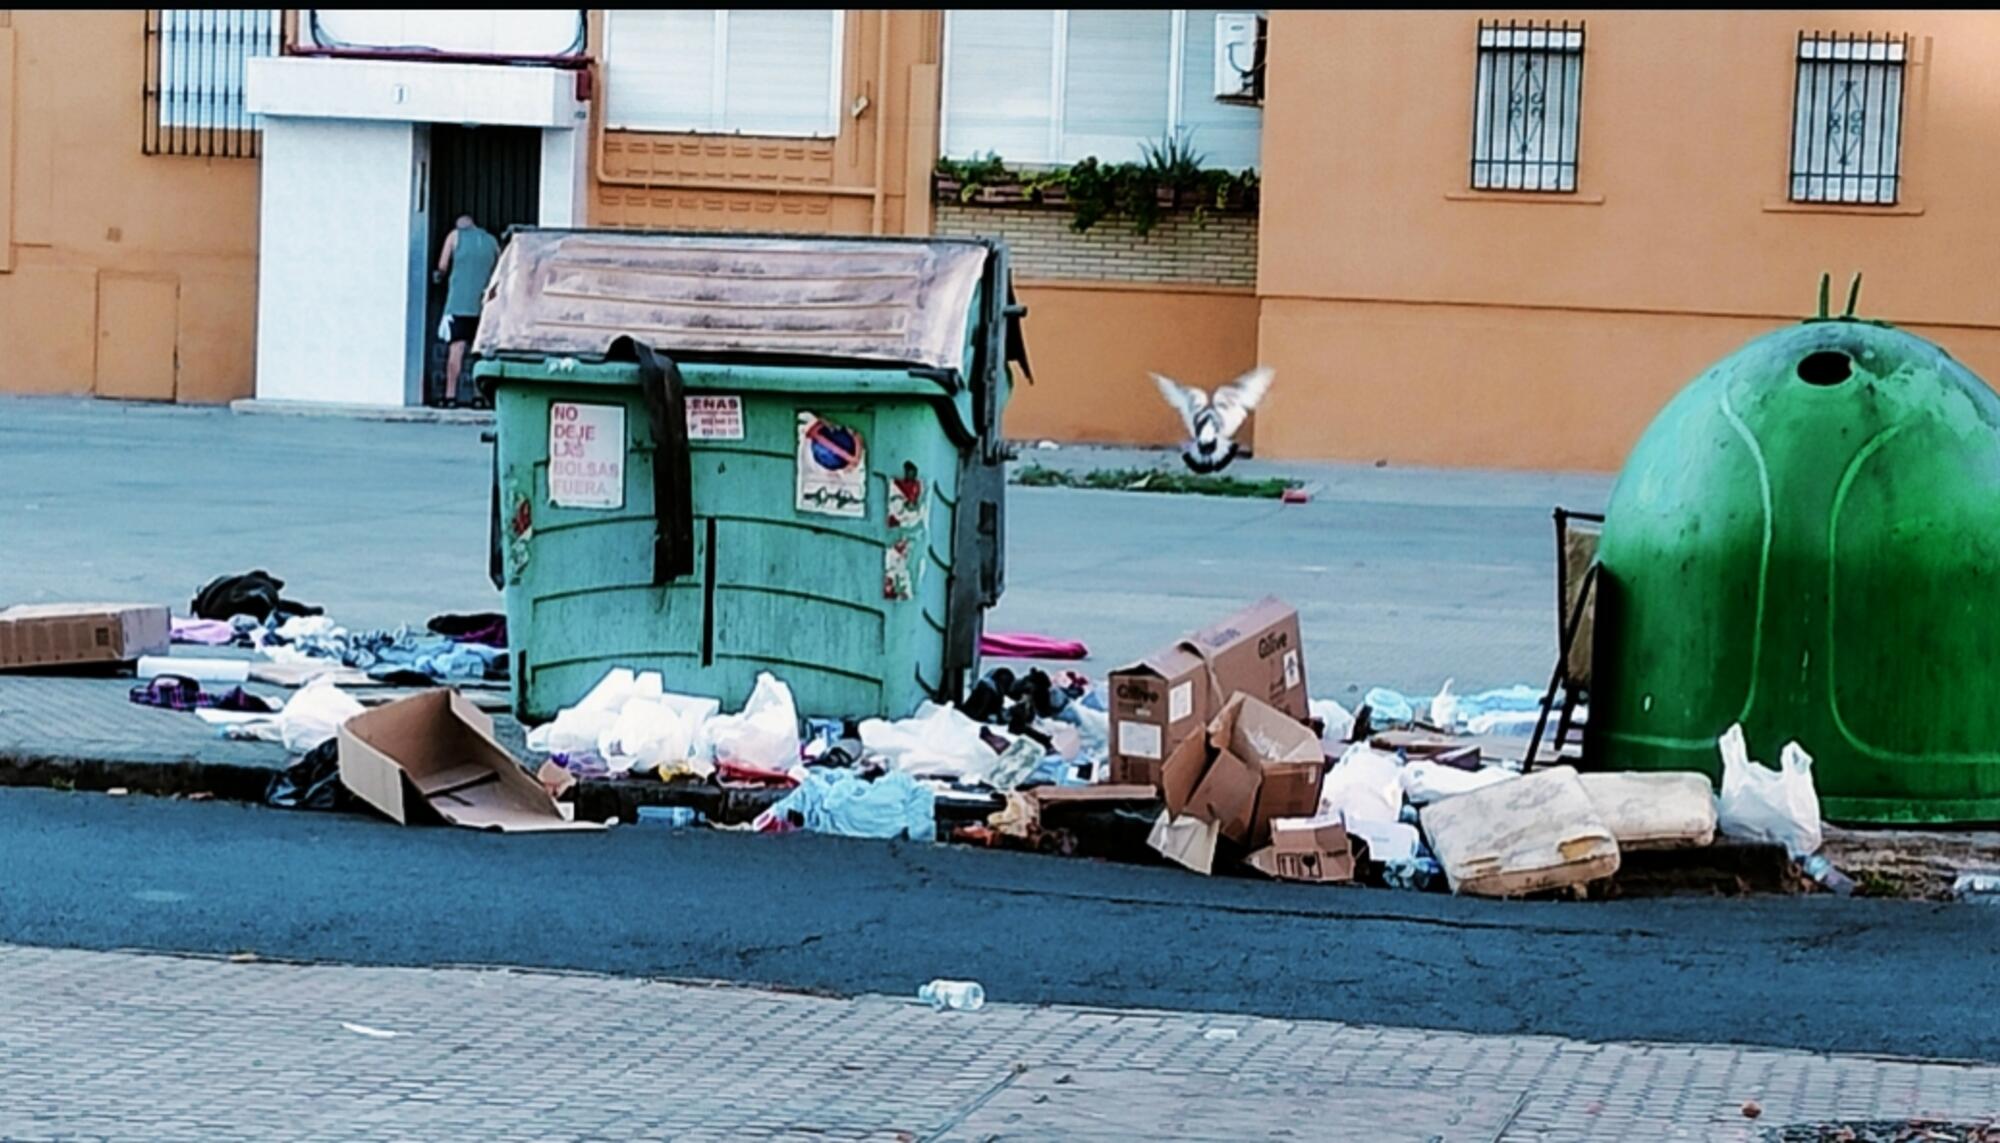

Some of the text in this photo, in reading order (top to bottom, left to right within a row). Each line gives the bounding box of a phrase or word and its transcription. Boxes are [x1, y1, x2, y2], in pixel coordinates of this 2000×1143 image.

[554, 406, 578, 421] NO
[554, 424, 595, 441] DEJE
[554, 441, 584, 458] LAS
[554, 461, 619, 478] BOLSAS
